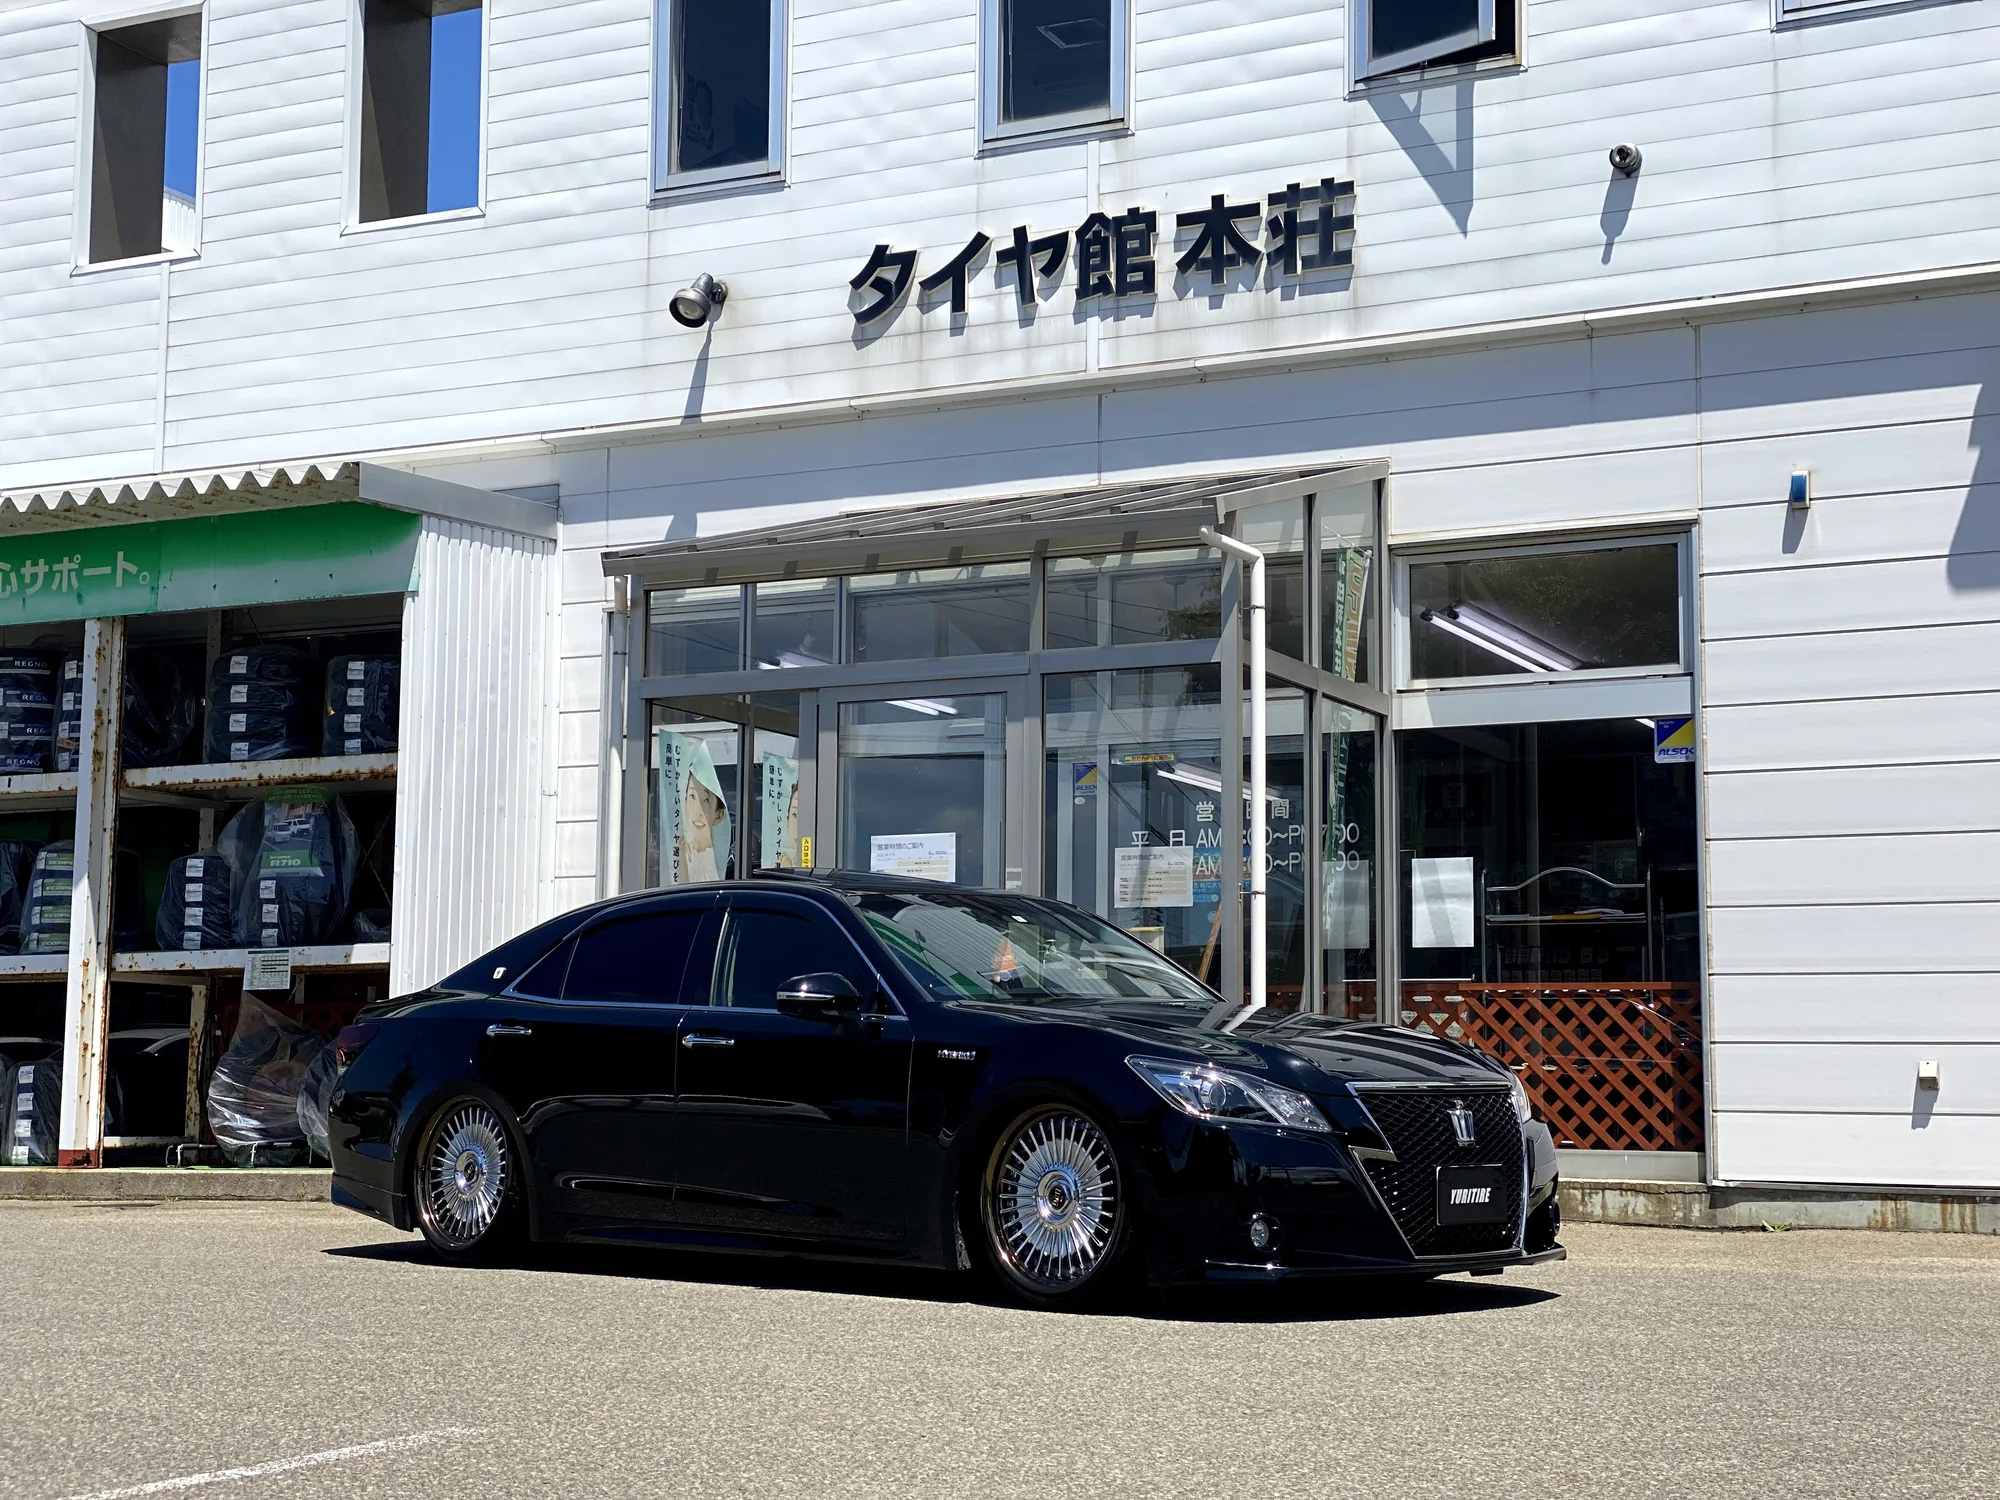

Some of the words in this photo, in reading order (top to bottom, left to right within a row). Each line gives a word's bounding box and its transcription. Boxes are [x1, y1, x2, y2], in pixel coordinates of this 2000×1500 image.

[848, 177, 1356, 327] タイヤ館本荘
[14, 660, 48, 668] REGNO
[1657, 746, 1695, 756] ALSOK
[270, 859, 301, 867] R710
[1450, 1187, 1491, 1205] YURITIRE
